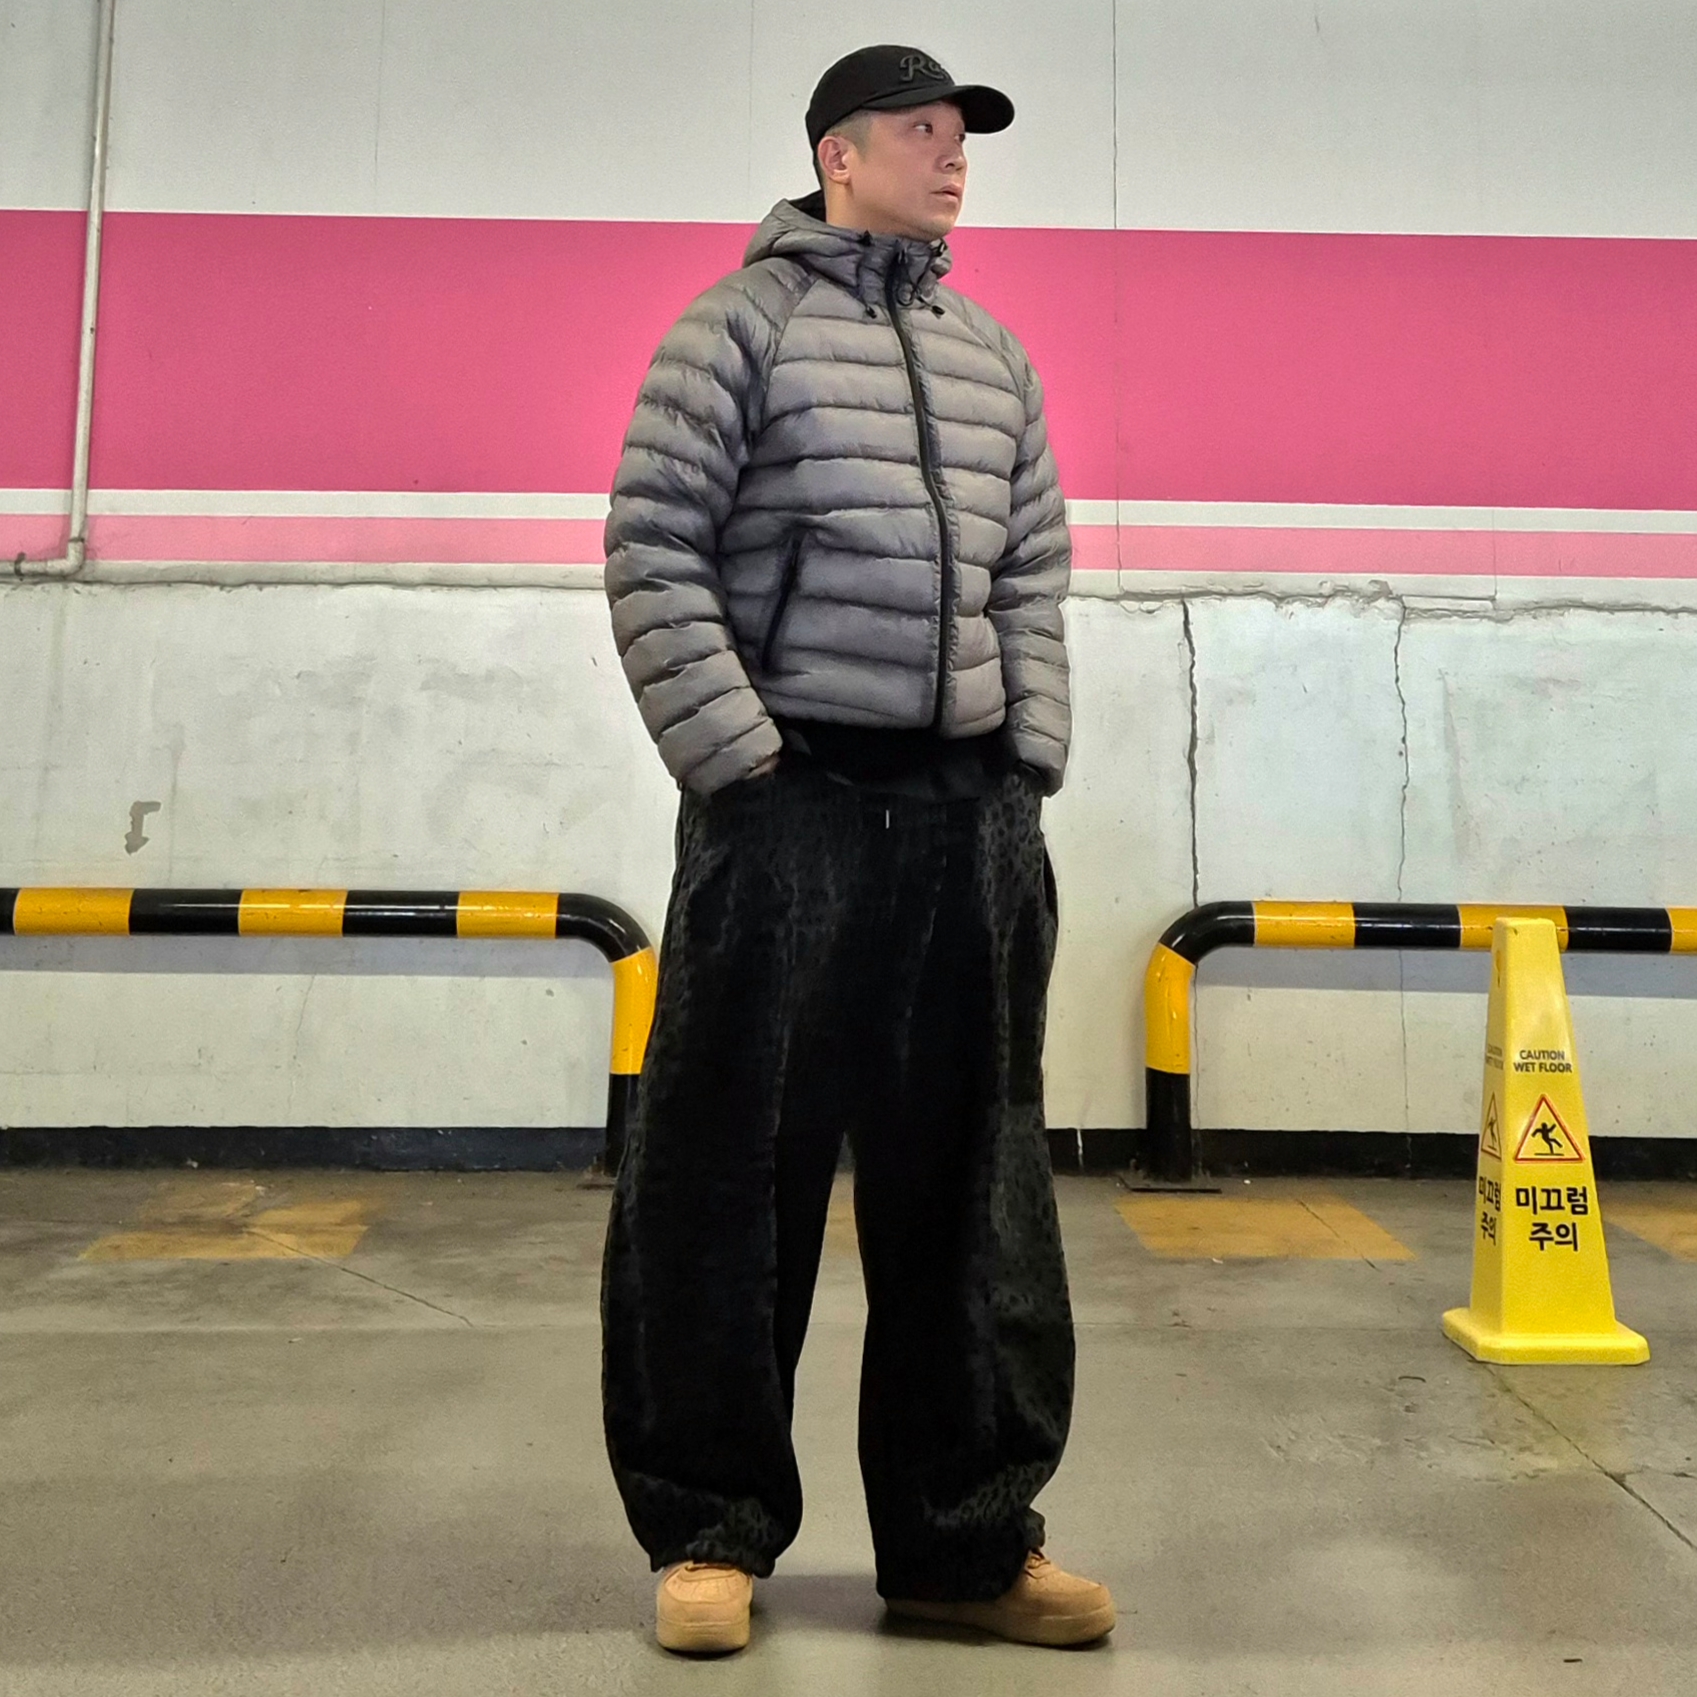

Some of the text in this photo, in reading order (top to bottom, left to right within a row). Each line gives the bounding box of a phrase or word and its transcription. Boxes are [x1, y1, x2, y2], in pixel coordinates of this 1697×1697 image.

[1519, 1049, 1565, 1060] CAUTION
[1514, 1062, 1537, 1073] WET
[1539, 1062, 1572, 1073] FLOOR
[1516, 1186, 1588, 1215] 미끄럼
[1529, 1222, 1579, 1251] 주의
